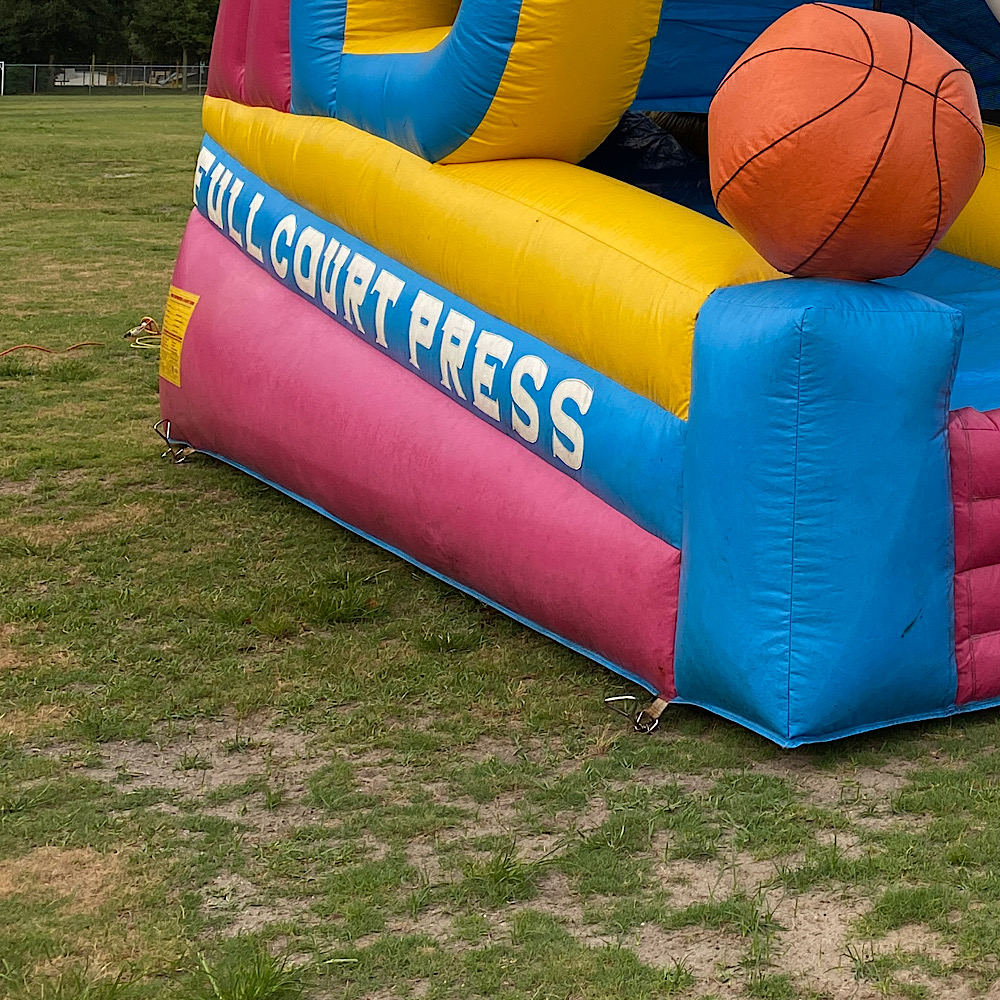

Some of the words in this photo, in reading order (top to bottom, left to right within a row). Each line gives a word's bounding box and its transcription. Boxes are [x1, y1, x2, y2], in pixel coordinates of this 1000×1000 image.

[193, 146, 264, 263] FULL
[270, 214, 405, 349] COURT
[409, 290, 594, 470] PRESS
